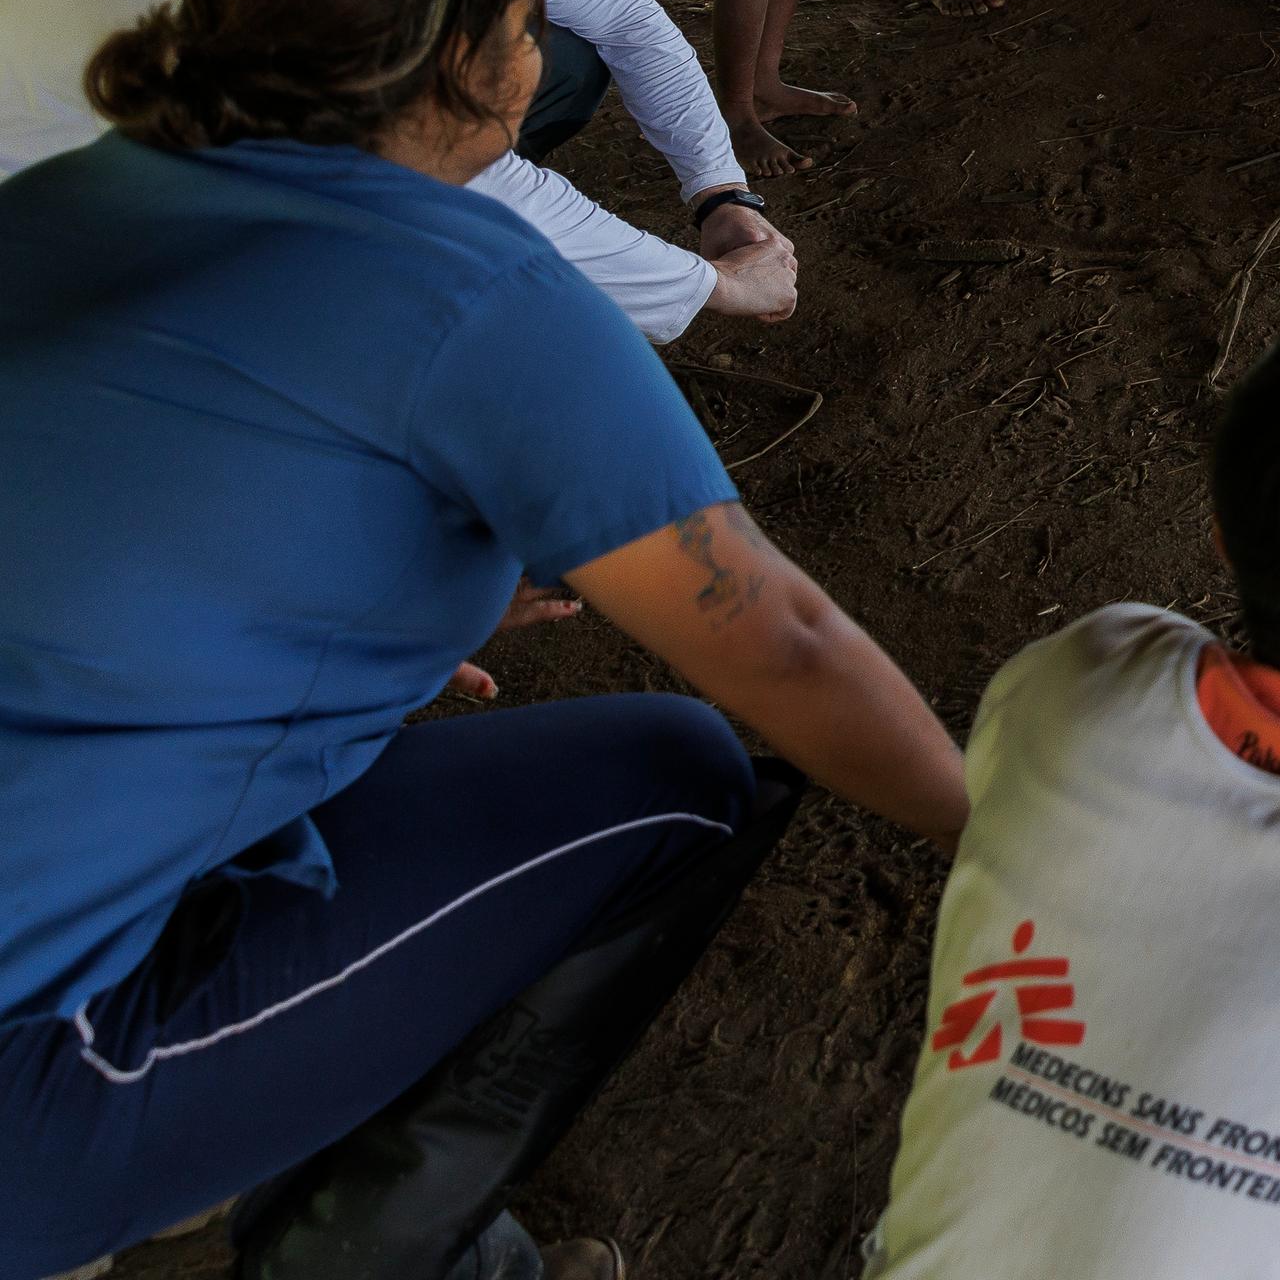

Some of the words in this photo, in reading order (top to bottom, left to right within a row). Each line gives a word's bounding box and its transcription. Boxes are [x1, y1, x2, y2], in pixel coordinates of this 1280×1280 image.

[989, 1075, 1097, 1140] MÉDICOS
[1096, 1122, 1149, 1162] SEM
[1010, 1041, 1131, 1110] MEDECINS
[1130, 1092, 1204, 1139] SANS
